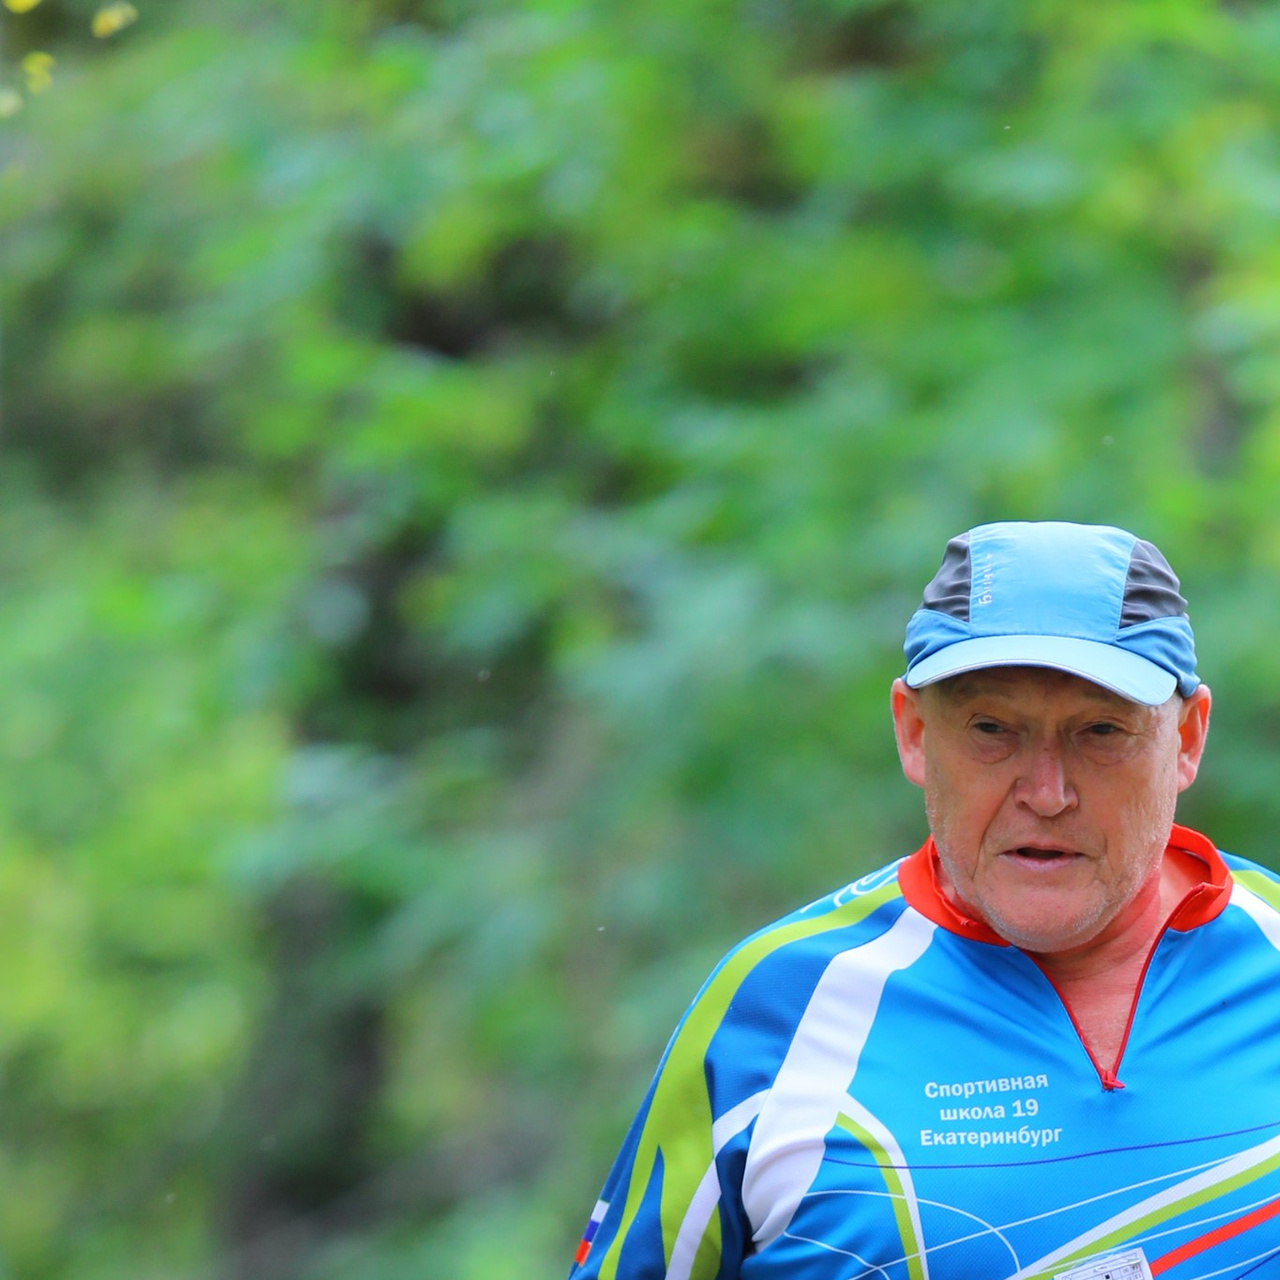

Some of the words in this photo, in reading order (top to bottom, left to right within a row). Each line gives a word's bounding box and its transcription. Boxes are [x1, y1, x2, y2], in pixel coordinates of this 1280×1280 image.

[924, 1074, 1048, 1098] Спортивная
[940, 1105, 1005, 1120] школа
[1012, 1099, 1039, 1117] 19
[920, 1126, 1062, 1147] Екатеринбург
